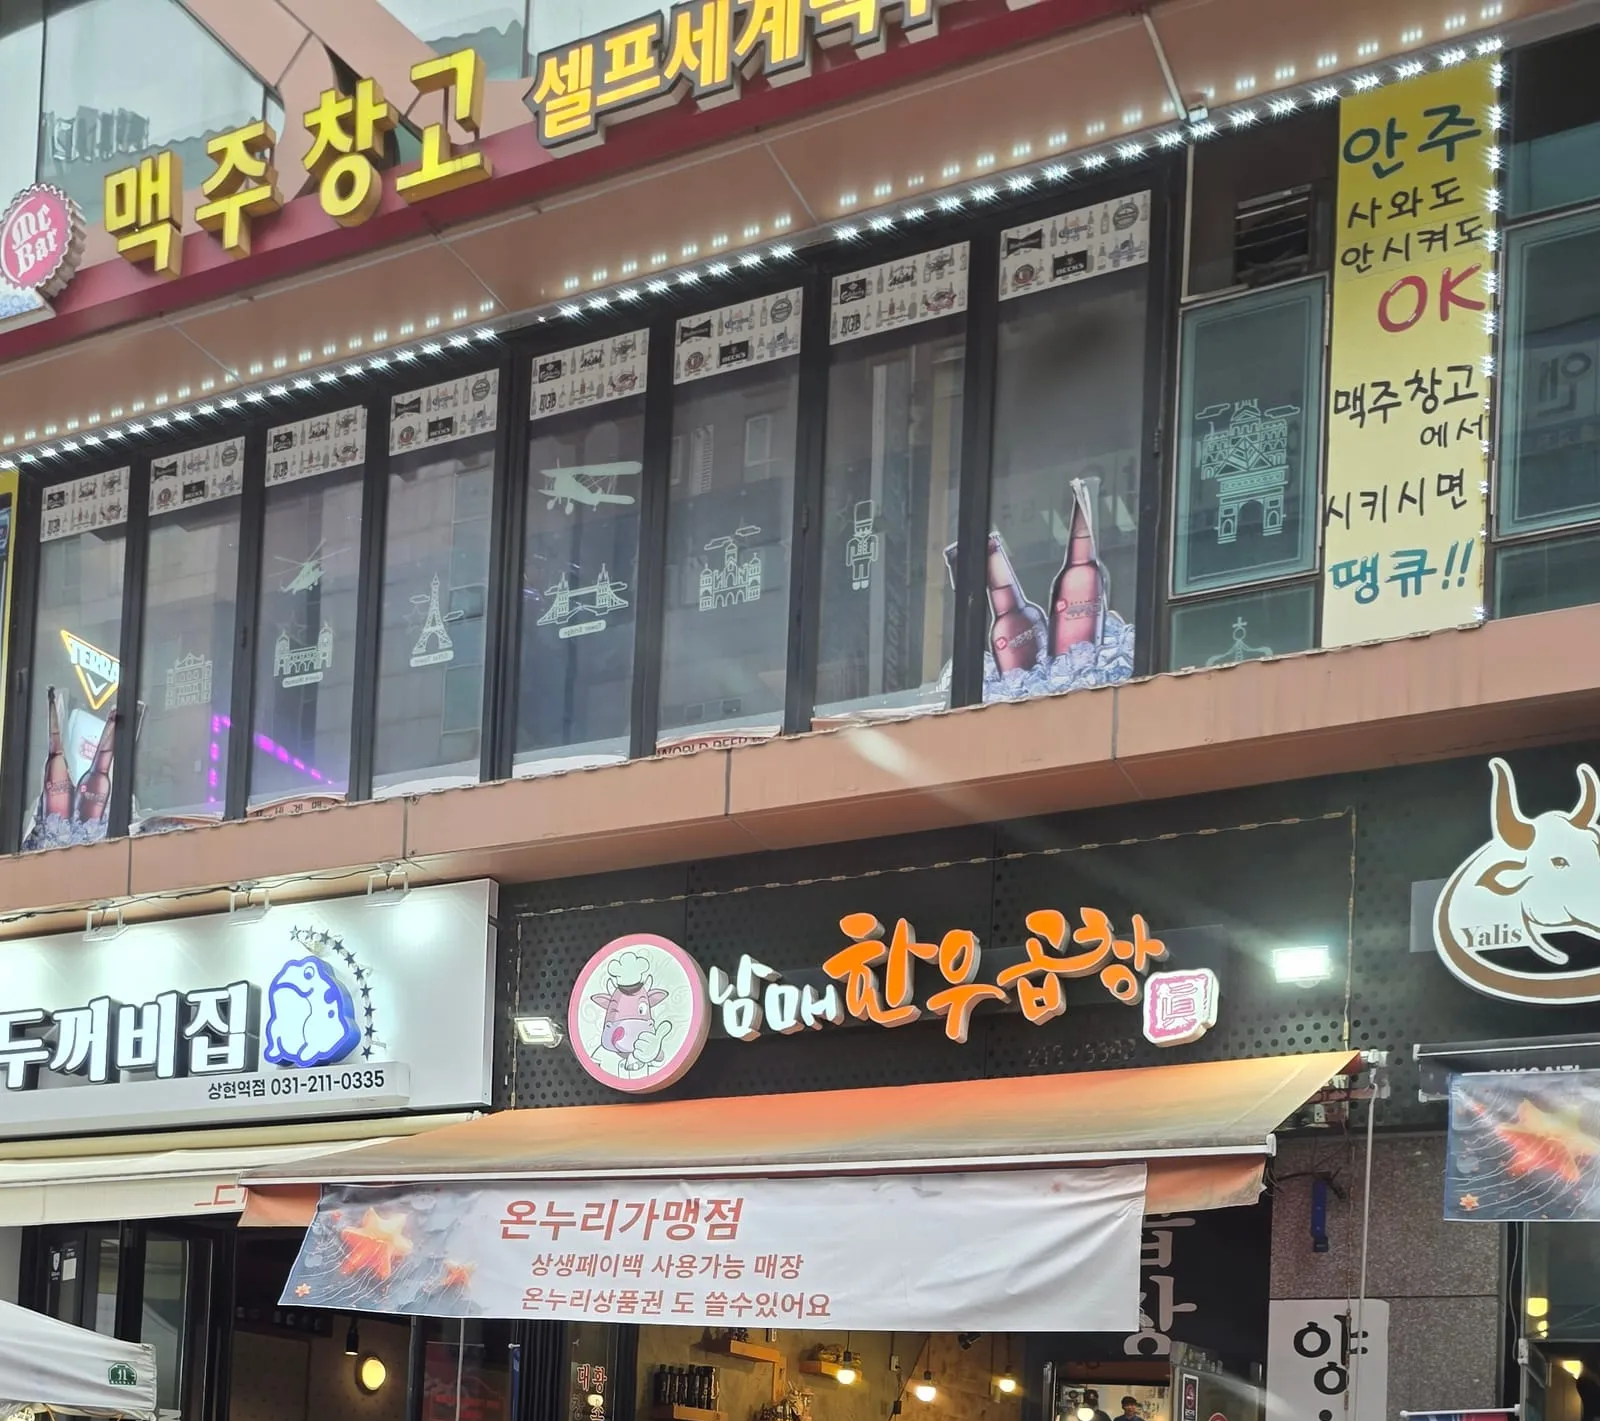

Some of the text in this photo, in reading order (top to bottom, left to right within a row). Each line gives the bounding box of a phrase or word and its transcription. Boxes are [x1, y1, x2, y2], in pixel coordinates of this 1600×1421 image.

[533, 0, 930, 138] 셀프세계
[104, 48, 490, 278] 맥주창고
[1342, 104, 1483, 179] 안주
[1347, 176, 1465, 229] 사와도
[1377, 262, 1486, 333] OK
[1333, 364, 1480, 428] 맥주창고
[1420, 414, 1484, 449] 에서
[1325, 468, 1467, 530] 시키시면
[1328, 538, 1475, 605] 땡큐!!
[1460, 923, 1522, 949] Yalis
[207, 1070, 385, 1100] 상현역점 031-211-0335
[499, 1197, 744, 1242] 온누리가맹점
[531, 1253, 805, 1281] 상생페이백 사용가능 매장
[521, 1286, 665, 1315] 온누리상품권
